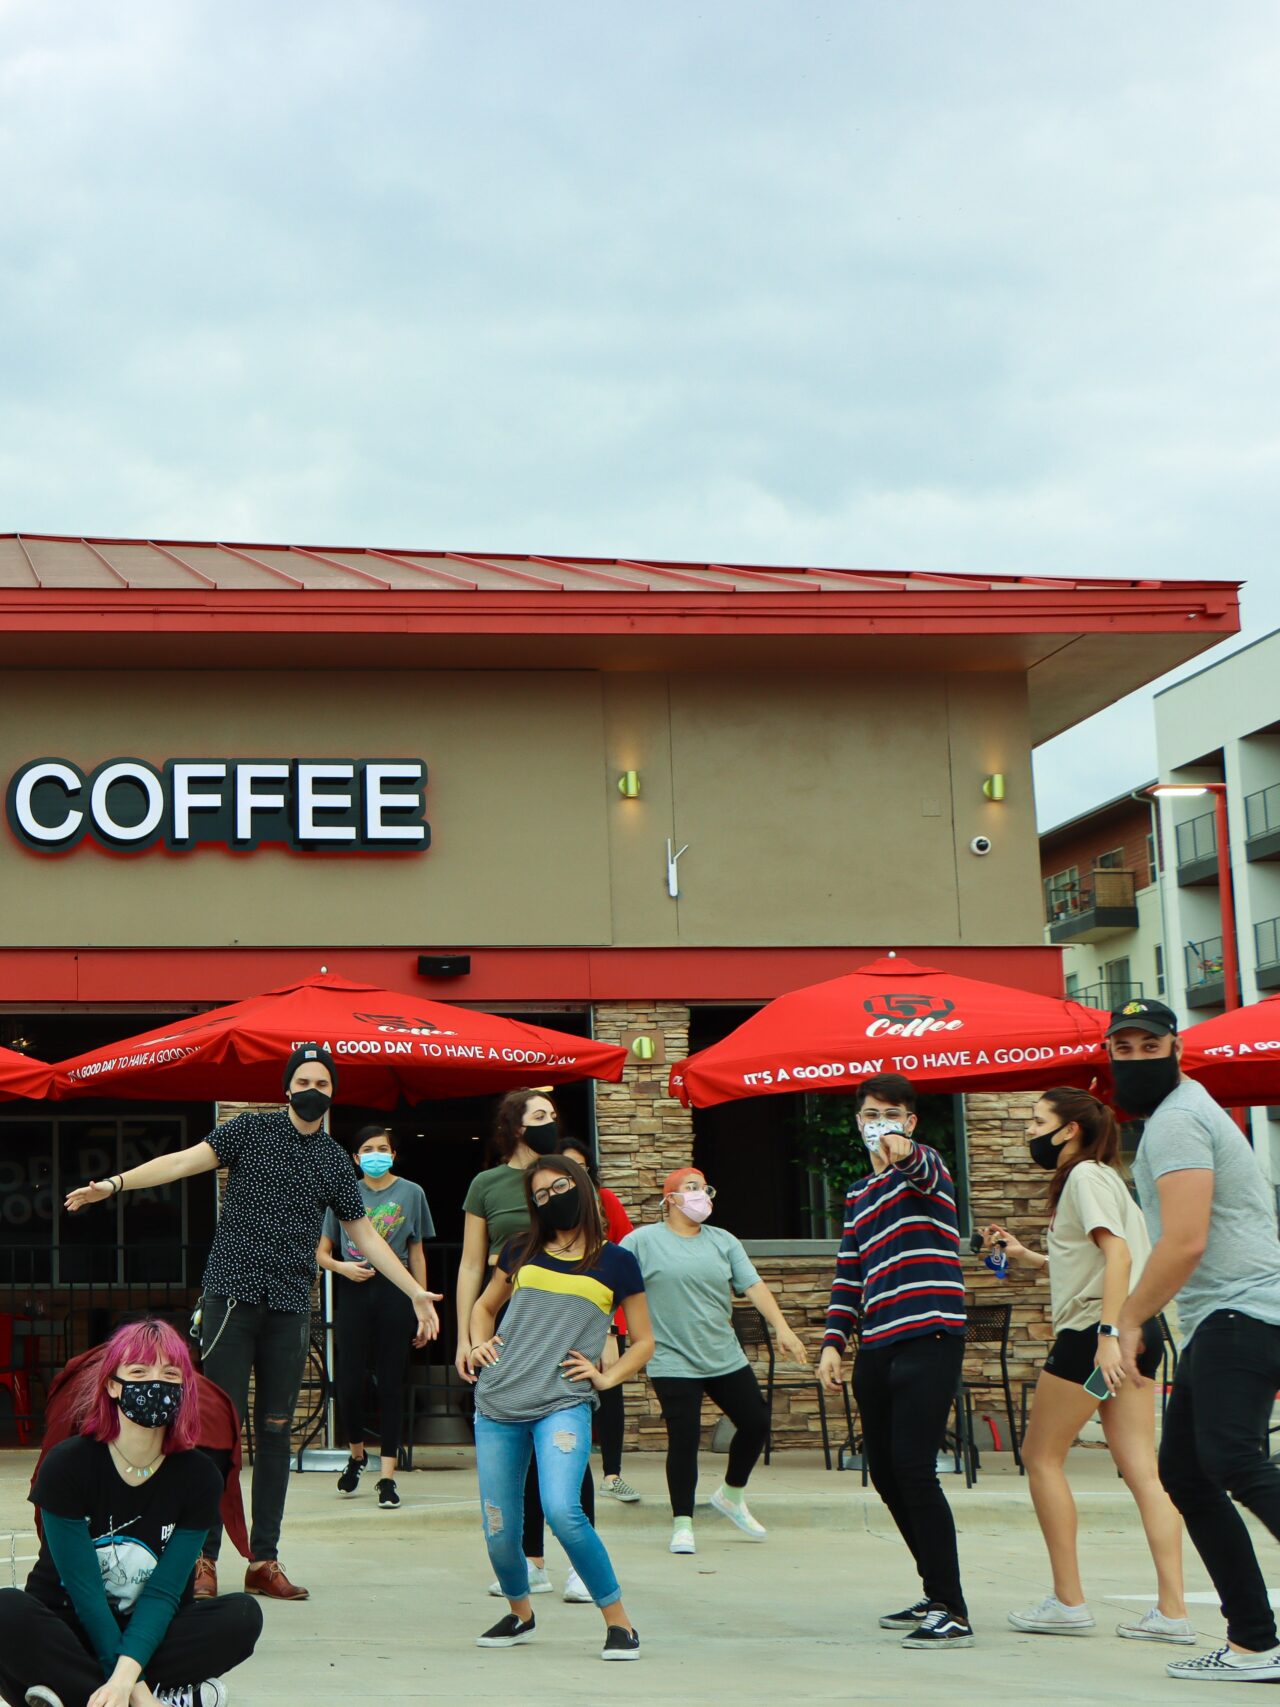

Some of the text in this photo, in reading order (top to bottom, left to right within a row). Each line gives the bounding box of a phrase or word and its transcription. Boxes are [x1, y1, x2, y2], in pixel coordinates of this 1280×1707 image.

[14, 762, 425, 841] COFFEE
[865, 1017, 965, 1038] Coffee
[81, 1062, 102, 1078] GOOD
[101, 1059, 117, 1073] DAY
[117, 1055, 129, 1070] TO
[128, 1052, 150, 1068] HAVE
[156, 1047, 187, 1064] GOOD
[322, 1041, 332, 1054] A
[336, 1040, 381, 1055] GOOD
[384, 1041, 413, 1055] DAY
[419, 1043, 442, 1057] TO
[445, 1044, 484, 1059] HAVE
[488, 1047, 500, 1060] A
[501, 1048, 546, 1064] GOOD
[1239, 1043, 1253, 1056] A
[743, 1043, 1098, 1085] IT'S A GOOD DAY TO HAVE A GOOD DAY
